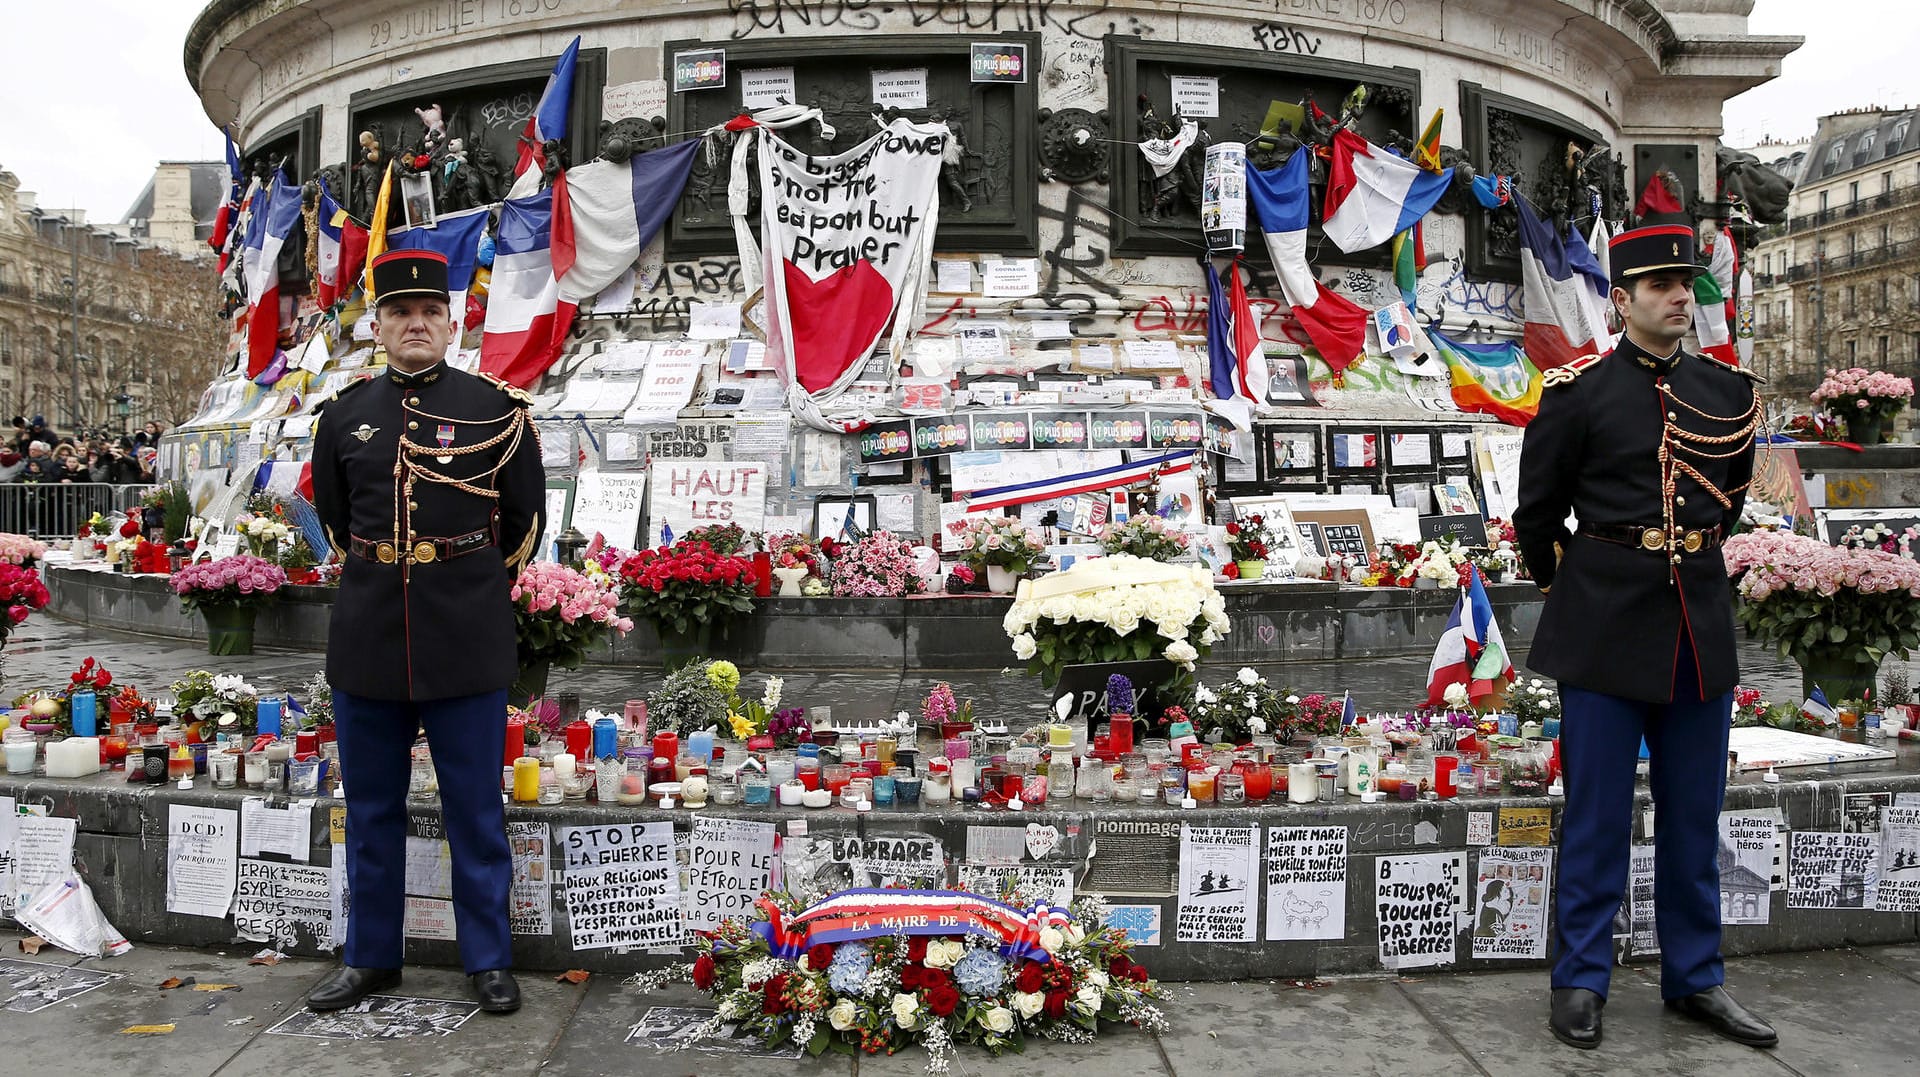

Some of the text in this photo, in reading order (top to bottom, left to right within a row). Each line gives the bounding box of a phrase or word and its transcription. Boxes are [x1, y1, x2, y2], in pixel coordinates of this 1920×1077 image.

[370, 1, 485, 48] 29 JUILLET
[678, 65, 720, 79] 17 PLUS JAMAIS
[974, 59, 1020, 70] 17 PLUS JAMAIS
[786, 177, 839, 203] not
[777, 200, 919, 238] eapon but
[791, 236, 900, 278] Prayer
[918, 429, 966, 444] 17 PLUS JAMAIS
[976, 428, 1026, 438] 17 PLUS JAMAIS
[1034, 426, 1083, 437] 17 PLUS JAMAIS
[1093, 427, 1143, 436] 17 PLUS JAMAIS
[1162, 426, 1178, 436] PLUS
[651, 442, 708, 458] HEBDO
[861, 436, 908, 451] 17 PLUS JAMAIS
[671, 468, 758, 496] HAUT
[692, 500, 734, 520] LES
[412, 816, 428, 825] VIVE
[696, 819, 724, 828] IRAK
[1730, 817, 1772, 828] La France
[417, 825, 431, 837] VIE
[568, 824, 646, 848] STOP
[1097, 820, 1180, 837] hommage
[1271, 830, 1308, 843] SAiNTE
[1310, 828, 1345, 840] MARiE
[1729, 828, 1754, 838] salue
[1737, 839, 1764, 850] héros
[1794, 833, 1870, 847] FOUS DE DiEU
[570, 844, 668, 866] LA GUERRE
[833, 839, 933, 862] BARBARE
[1302, 846, 1313, 856] DE
[1318, 843, 1343, 856] DiEU
[176, 854, 216, 864] POURQUOI
[695, 846, 771, 870] POUR LE
[1309, 859, 1326, 870] TON
[240, 863, 280, 880] IRAK
[990, 868, 1019, 876] MORTS
[1791, 859, 1868, 876] TOUCHEZ PAS
[294, 875, 328, 886] MORTS
[1269, 871, 1344, 885] TROP PARESSEUX
[284, 888, 303, 897] 300
[307, 890, 330, 898] 000
[697, 890, 752, 909] STOP
[1379, 883, 1424, 901] DE TOUS
[1788, 891, 1836, 907] ENFANTS
[238, 900, 332, 920] NOUS SOMME
[571, 899, 656, 917] PASSERONS
[687, 910, 700, 921] LA
[1379, 901, 1452, 922] TOUCHEZ
[852, 920, 871, 932] LA
[880, 915, 928, 928] MAIRE
[939, 915, 958, 927] DE
[1207, 916, 1246, 924] CERVEAU
[1380, 921, 1452, 941] PAS NOS
